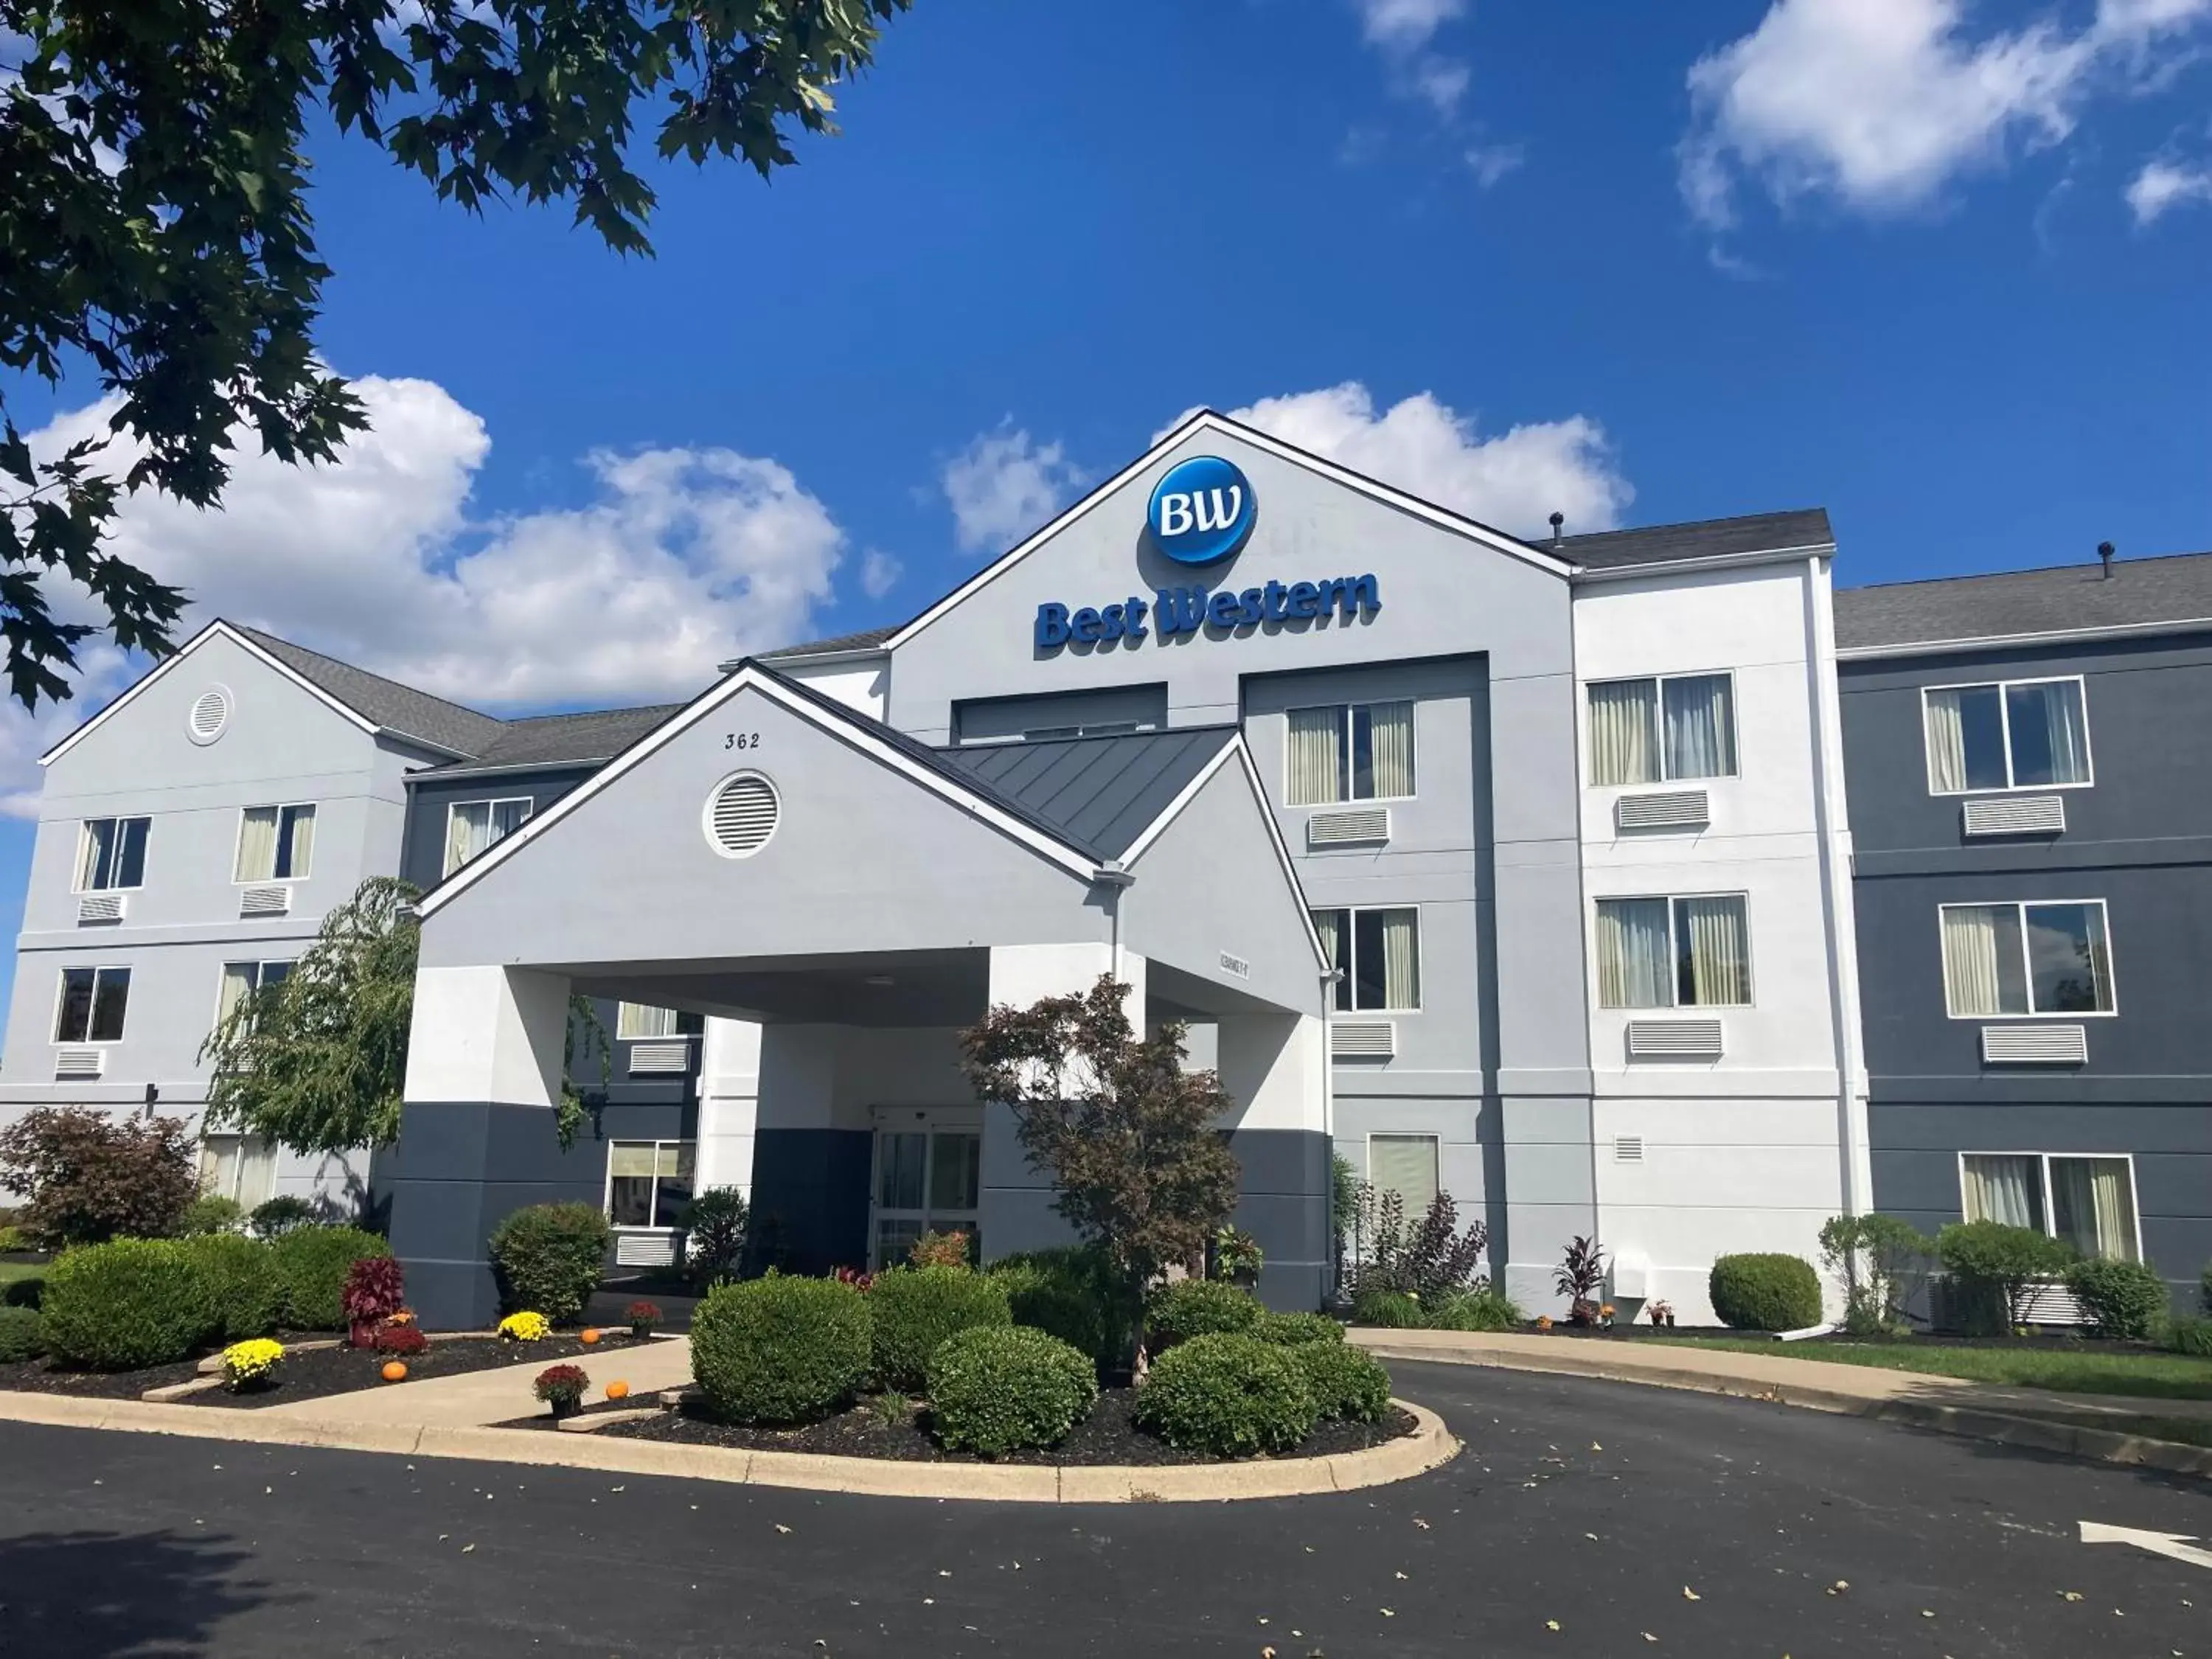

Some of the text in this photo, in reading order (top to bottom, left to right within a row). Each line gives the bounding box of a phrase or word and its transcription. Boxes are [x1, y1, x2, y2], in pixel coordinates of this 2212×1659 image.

[1161, 485, 1242, 537] BW
[1038, 573, 1382, 648] Best Western
[725, 733, 759, 750] 362
